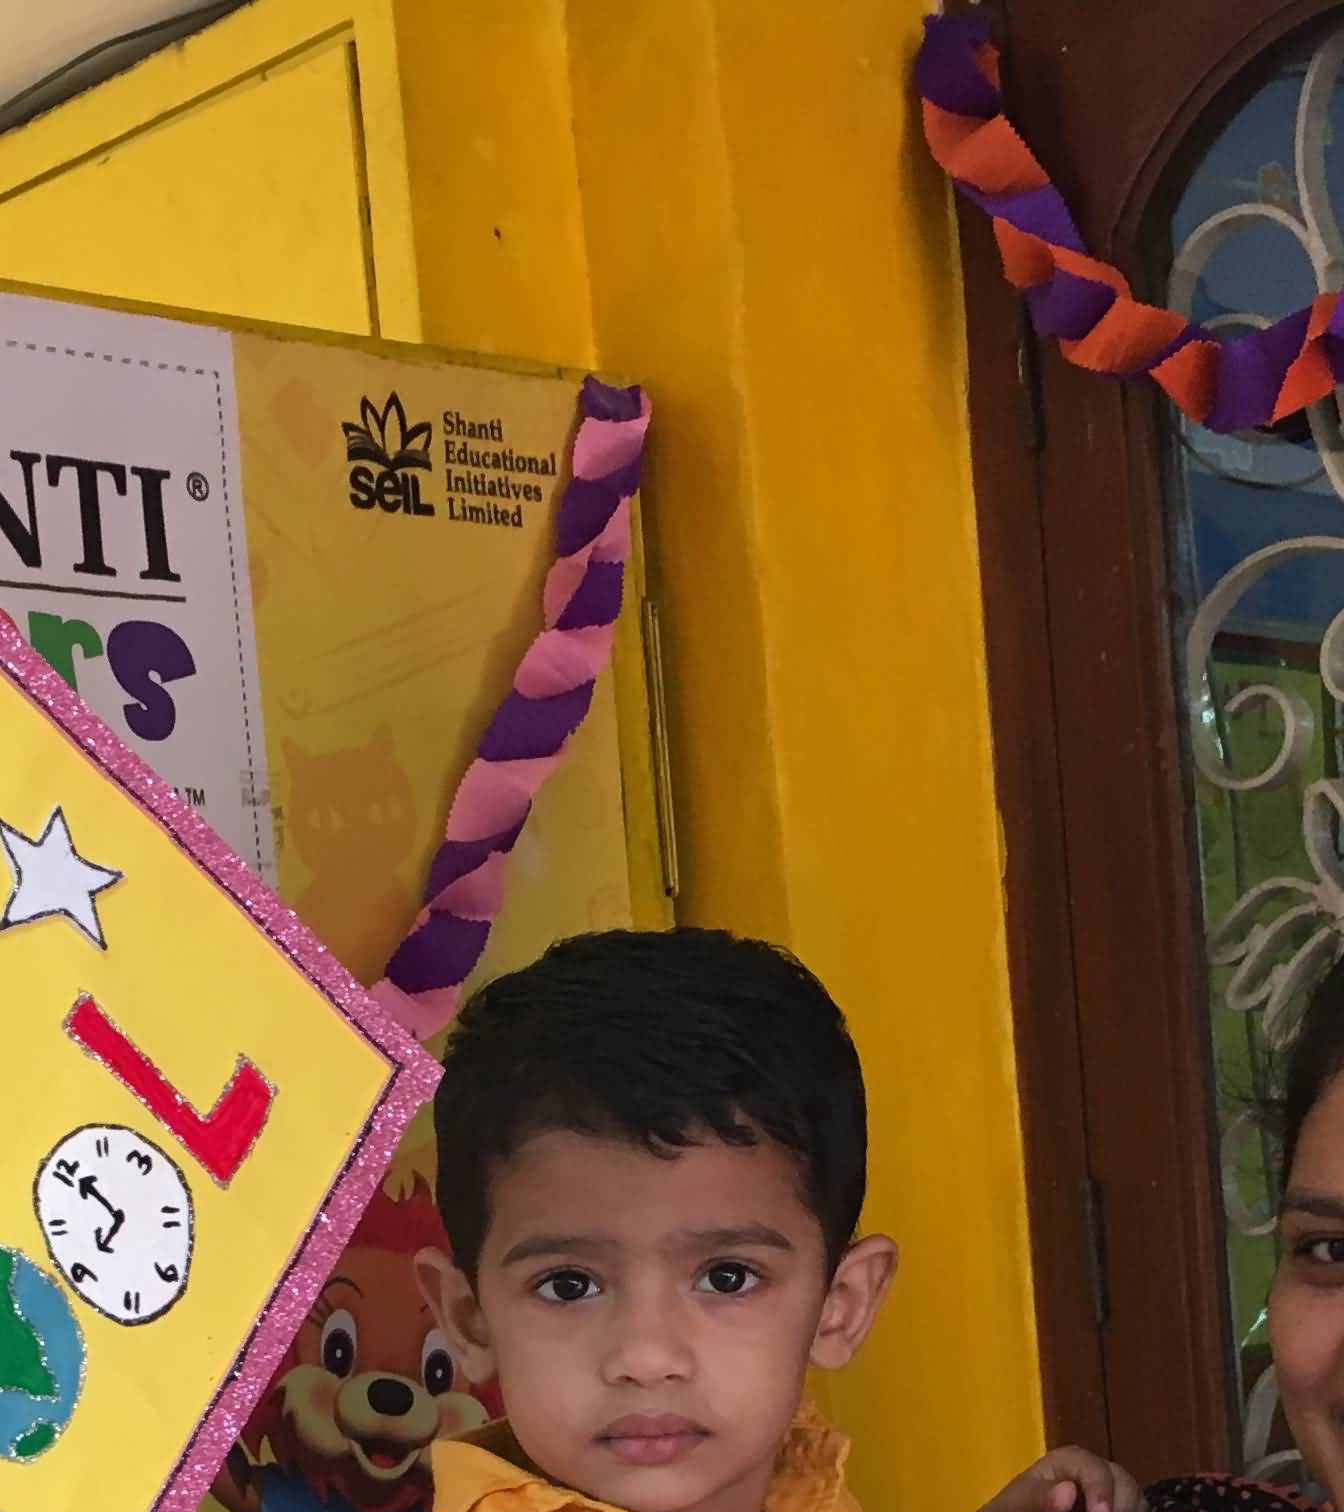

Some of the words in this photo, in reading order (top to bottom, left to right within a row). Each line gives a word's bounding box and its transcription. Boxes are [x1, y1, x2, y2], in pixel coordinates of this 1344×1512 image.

[443, 411, 504, 442] Shanti
[444, 440, 557, 476] Educational
[446, 468, 543, 502] Initiatives
[448, 497, 523, 528] Limited
